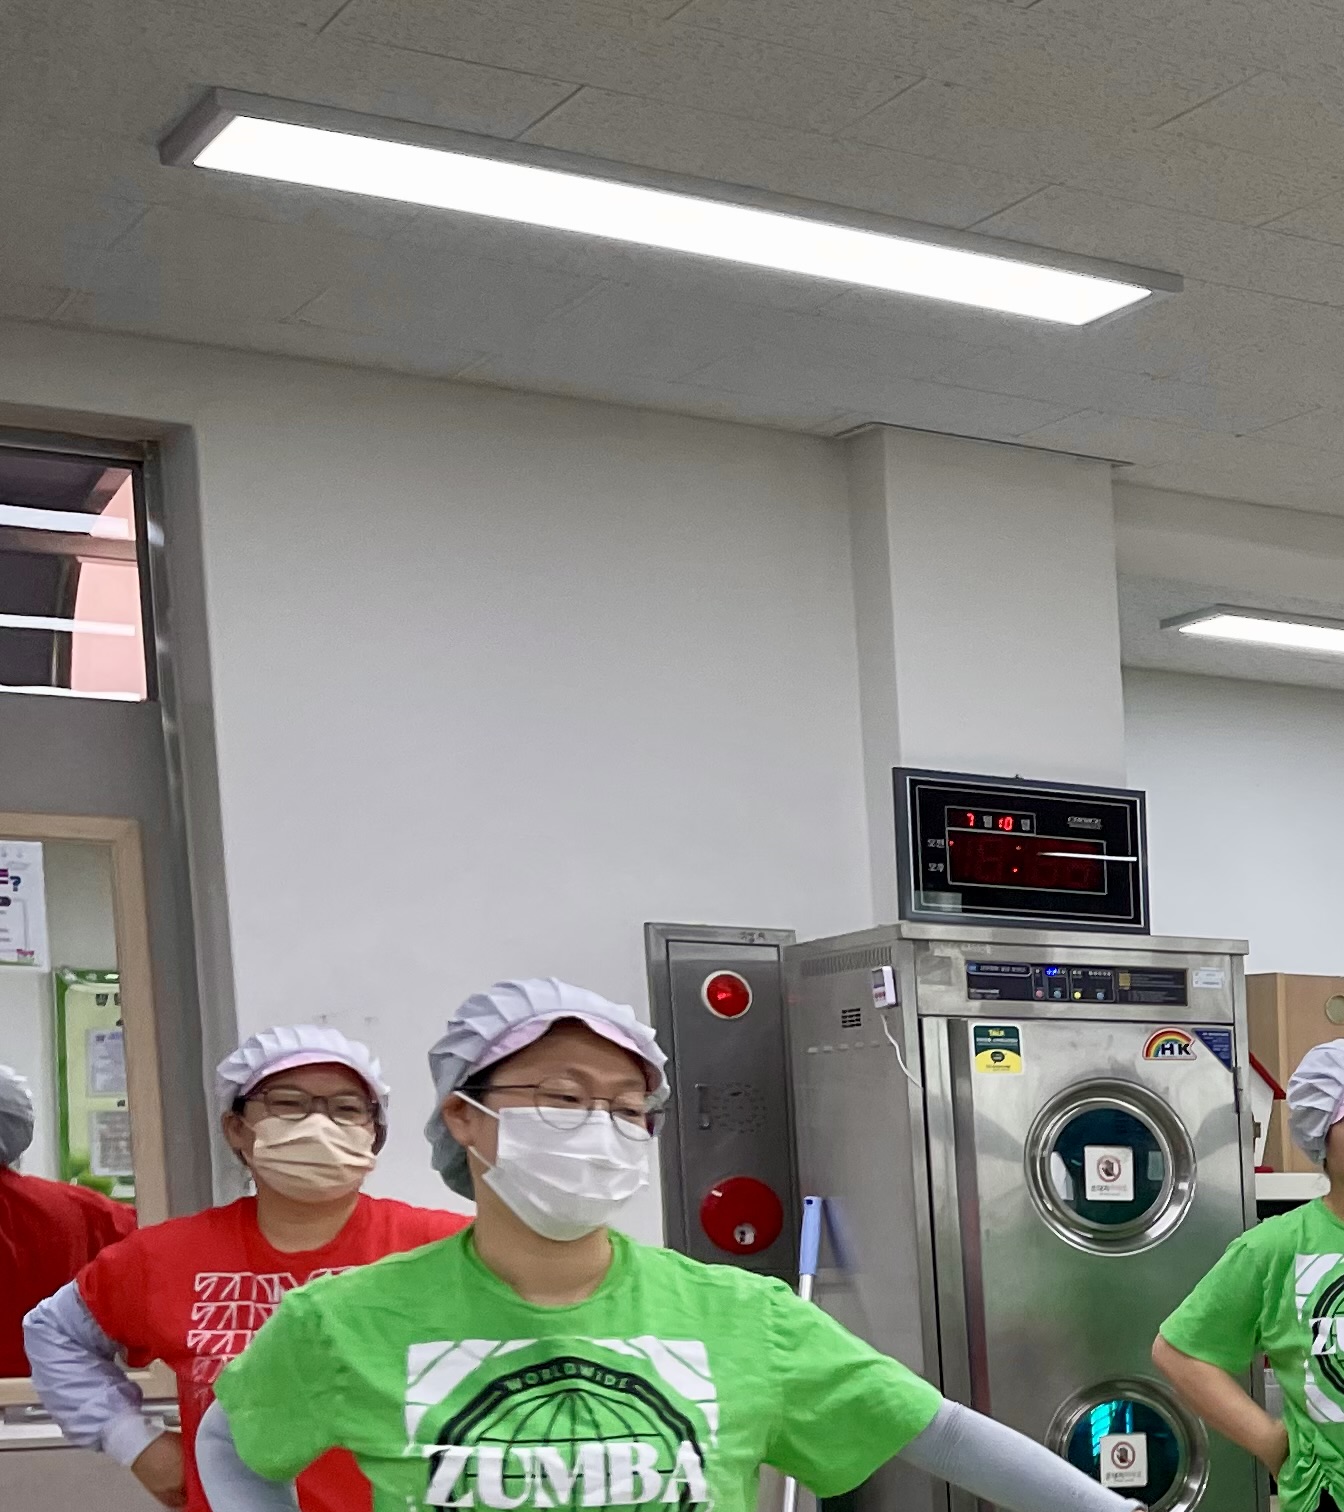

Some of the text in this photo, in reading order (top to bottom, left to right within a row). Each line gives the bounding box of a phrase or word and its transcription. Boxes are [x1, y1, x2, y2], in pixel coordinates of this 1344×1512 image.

[1160, 1042, 1192, 1056] HK
[503, 1362, 630, 1391] WORLDWIDE
[424, 1440, 707, 1510] ZUMBA
